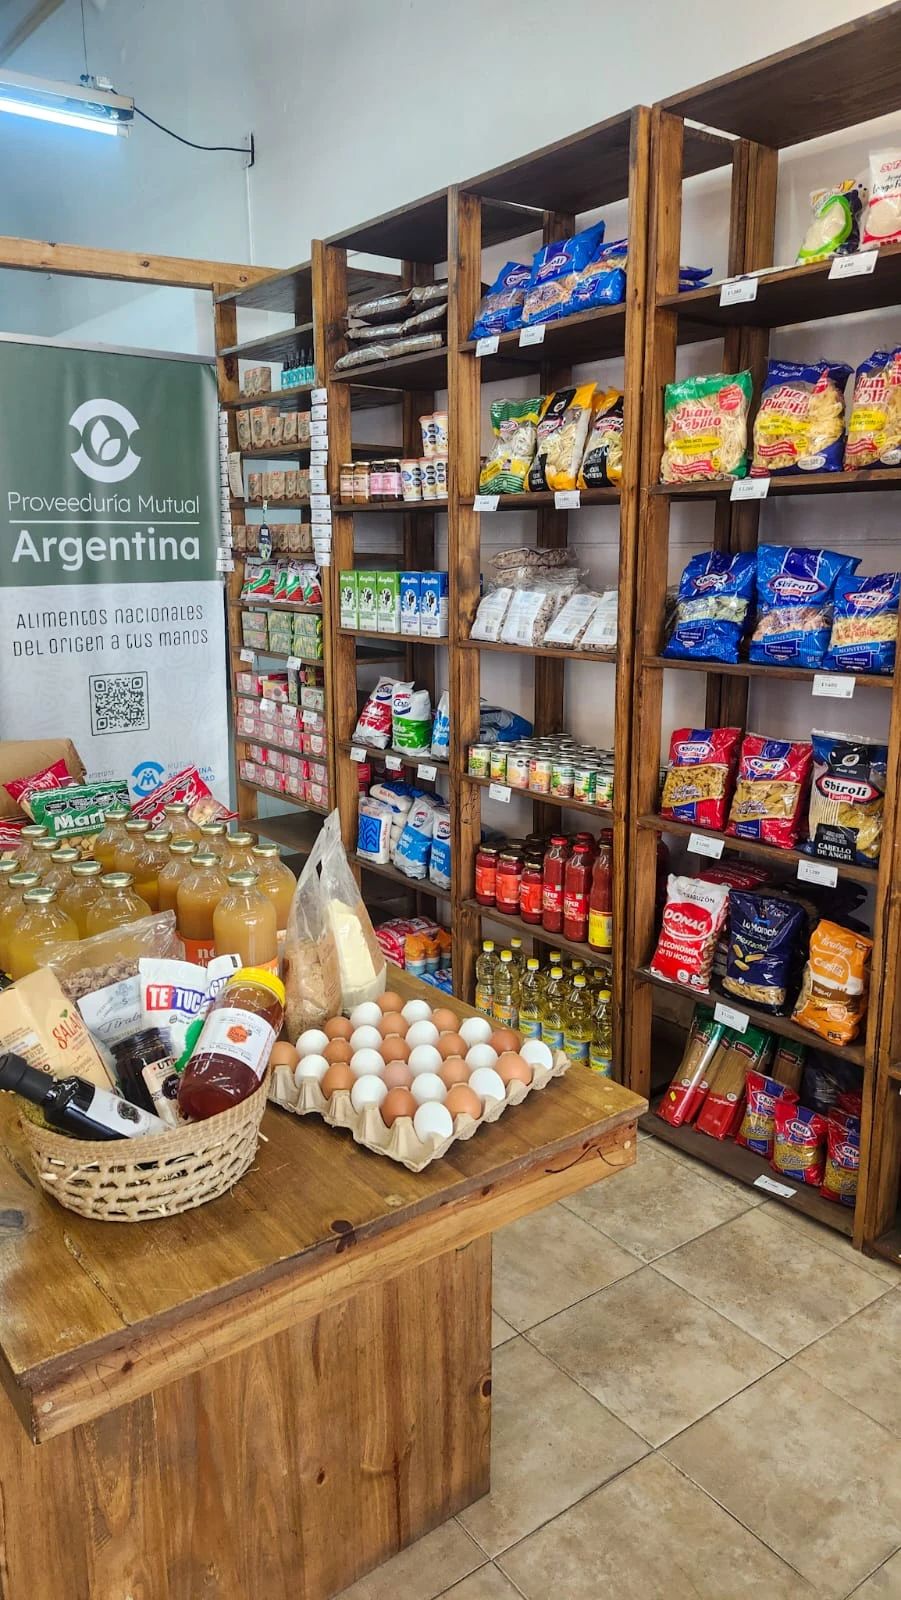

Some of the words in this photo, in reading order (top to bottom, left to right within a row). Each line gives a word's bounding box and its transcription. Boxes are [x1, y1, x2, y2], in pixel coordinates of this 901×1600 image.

[8, 491, 131, 513] Proveeduría
[138, 494, 200, 514] Mutual
[11, 527, 200, 571] Argentina
[823, 779, 868, 797] Sbiroli
[817, 842, 852, 855] CABELLO
[149, 985, 169, 1008] TE
